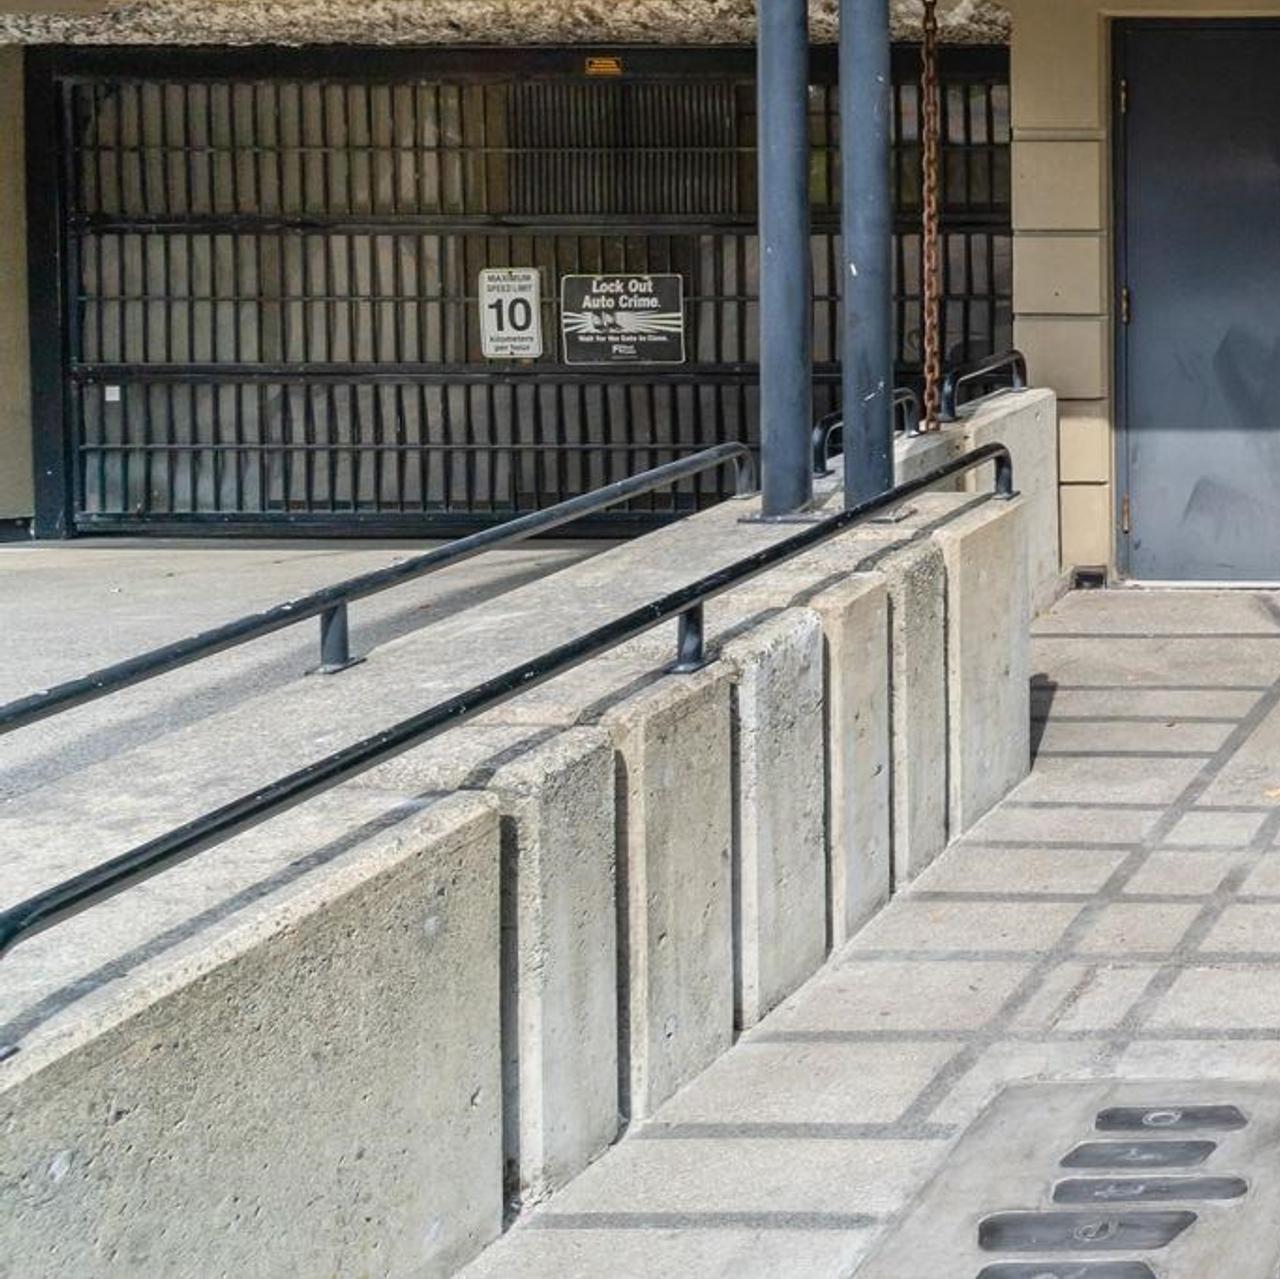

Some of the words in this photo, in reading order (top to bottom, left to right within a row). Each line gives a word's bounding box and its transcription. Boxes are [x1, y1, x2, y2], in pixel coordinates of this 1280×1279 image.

[592, 280, 624, 293] Lock
[628, 280, 653, 293] Out
[582, 295, 615, 308] Auto
[618, 295, 661, 308] Crime.
[488, 297, 532, 332] 10
